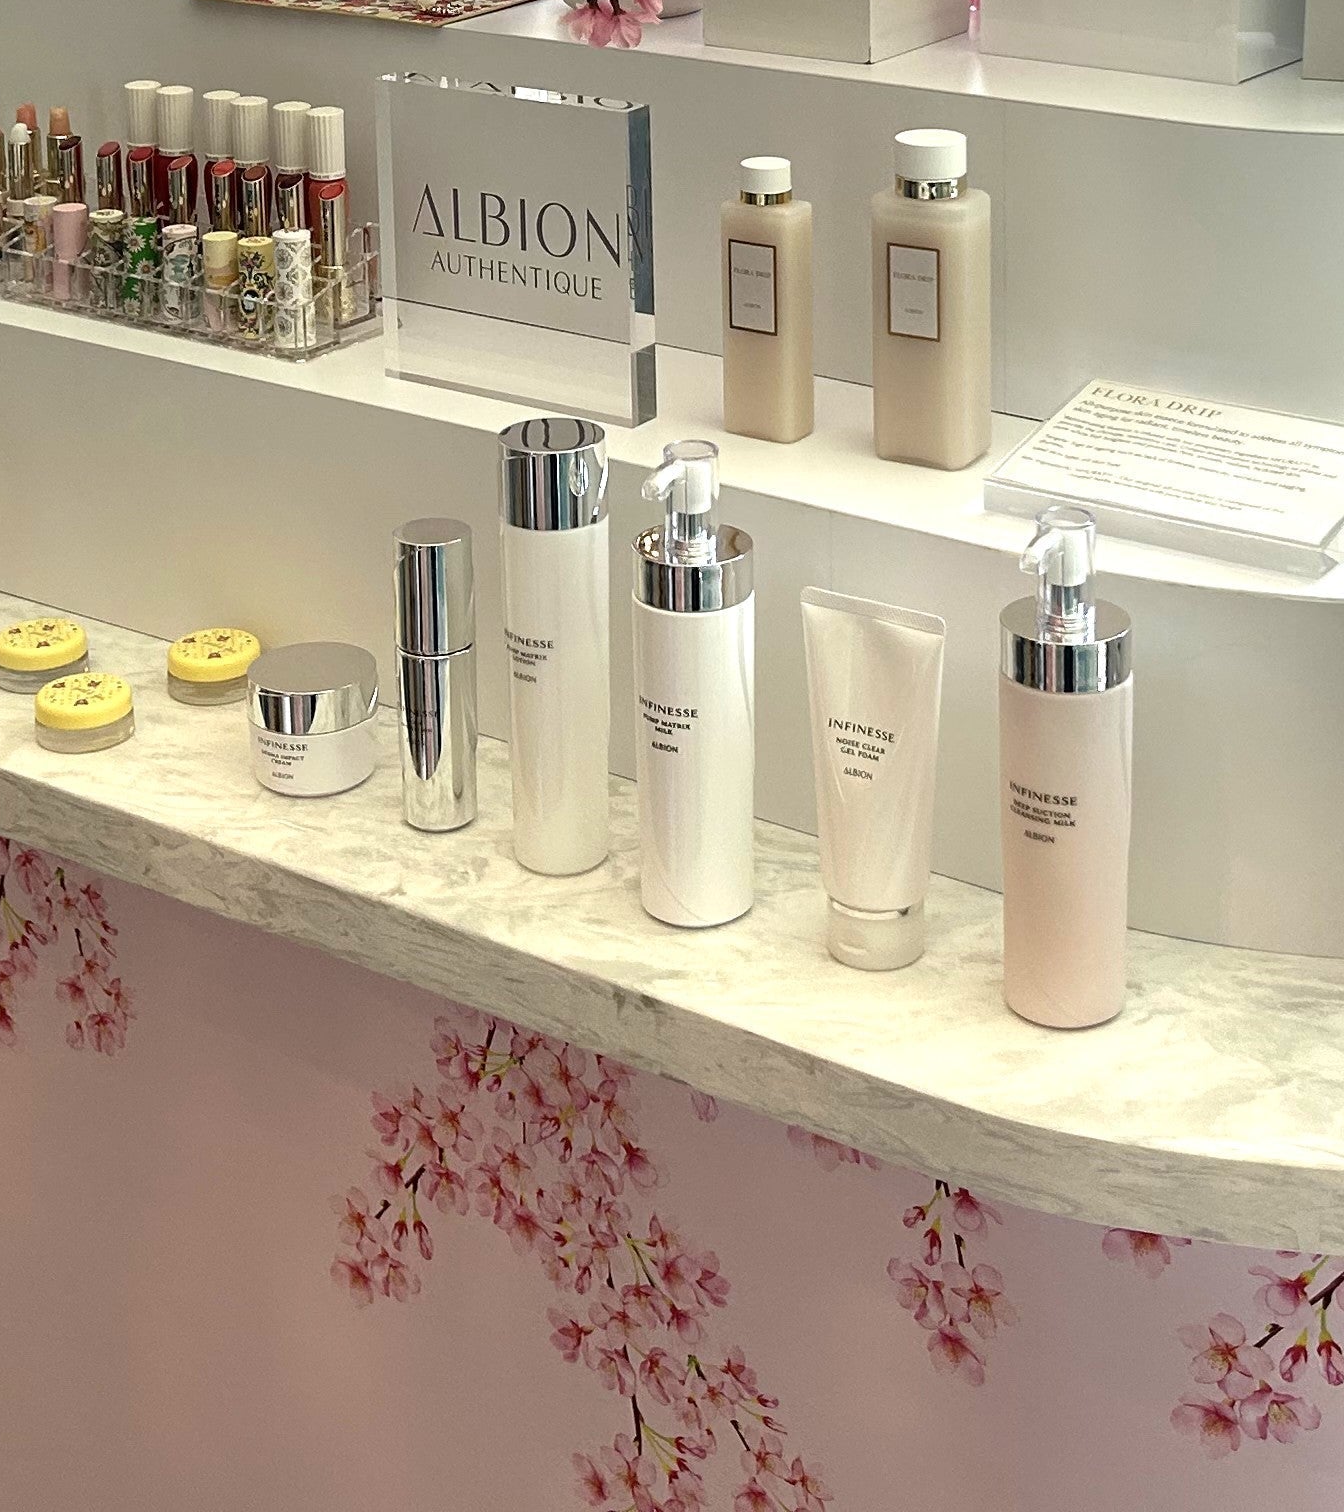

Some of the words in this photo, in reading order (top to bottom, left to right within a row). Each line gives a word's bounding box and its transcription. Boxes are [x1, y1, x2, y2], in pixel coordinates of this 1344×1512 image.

[412, 183, 622, 269] ALBION
[431, 250, 603, 300] AUTHENTIQUE
[1092, 387, 1160, 407] FLORA
[1167, 401, 1222, 418] DRIP
[639, 695, 698, 719] INFINESSE
[828, 717, 895, 743] INFINESSE
[843, 767, 873, 780] ALBION
[1009, 780, 1078, 806] INFINESSE
